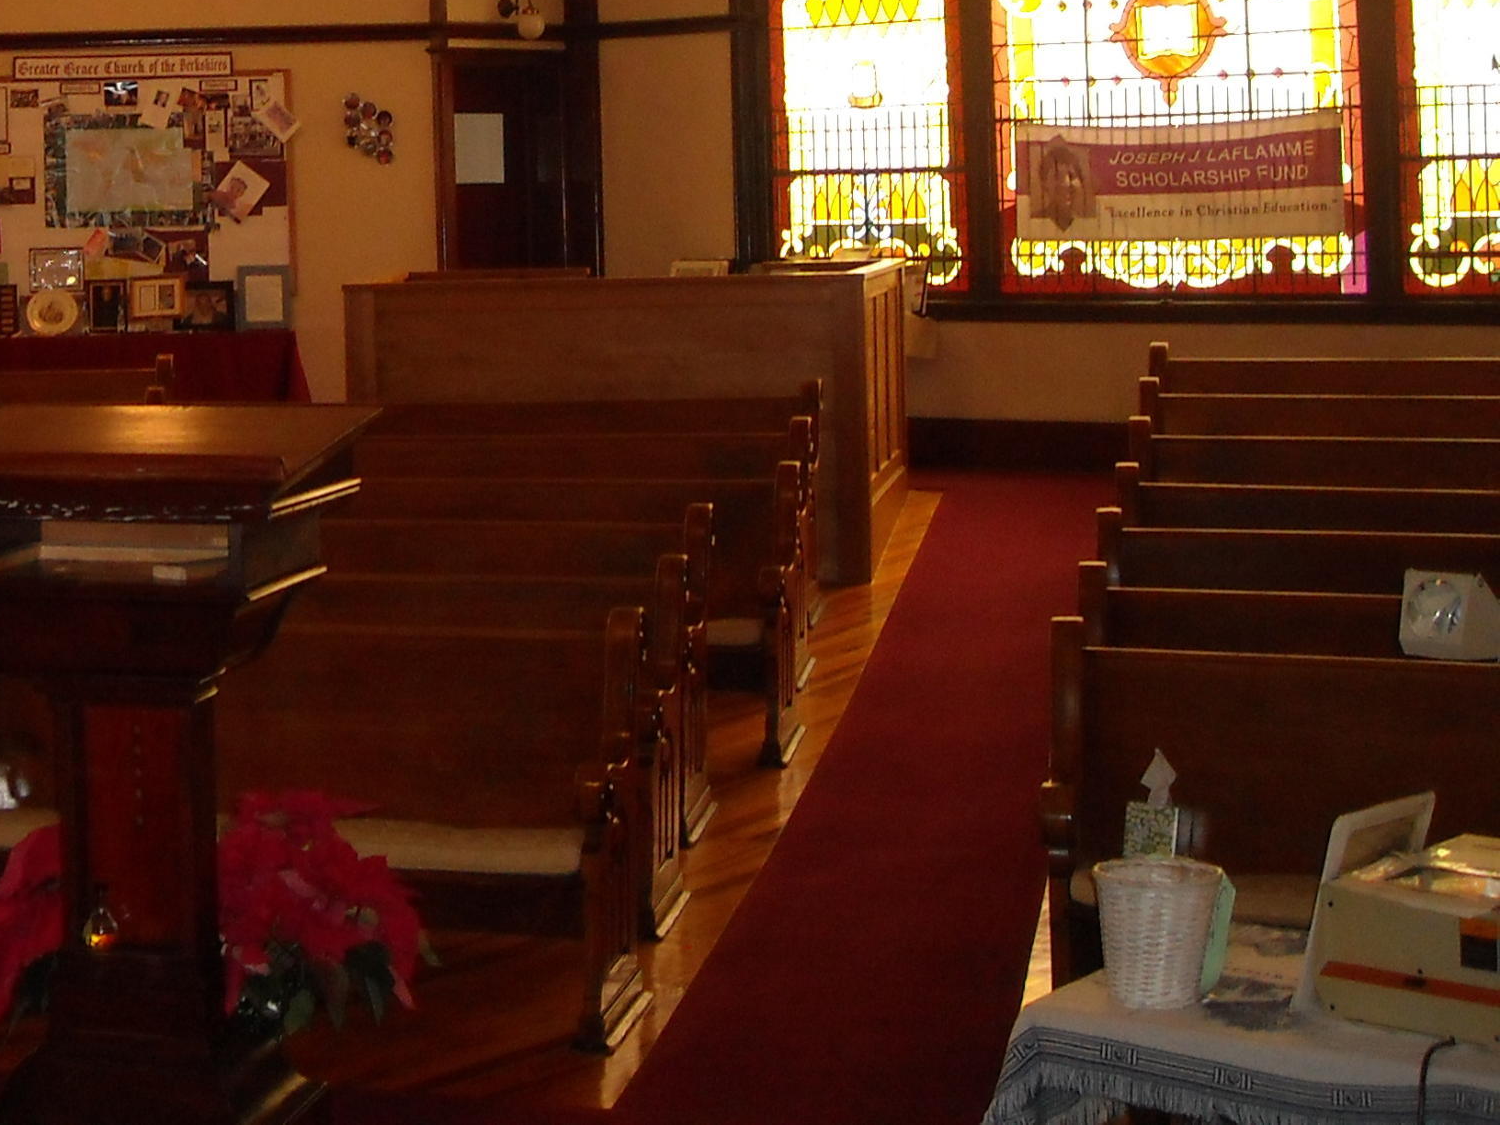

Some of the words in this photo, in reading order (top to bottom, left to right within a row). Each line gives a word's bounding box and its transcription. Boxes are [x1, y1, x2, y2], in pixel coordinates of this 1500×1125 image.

[17, 61, 61, 76] Greater
[64, 61, 100, 76] Grace
[104, 59, 145, 75] Church
[148, 58, 159, 76] of
[160, 58, 176, 73] the
[179, 57, 228, 73] Berkshires
[1109, 150, 1186, 166] JOSEPH
[1206, 139, 1316, 163] LAFLAMME
[1115, 168, 1251, 188] SCHOLARSHIP
[1256, 163, 1309, 181] FUND
[1180, 204, 1193, 217] in
[1196, 201, 1259, 218] Christian
